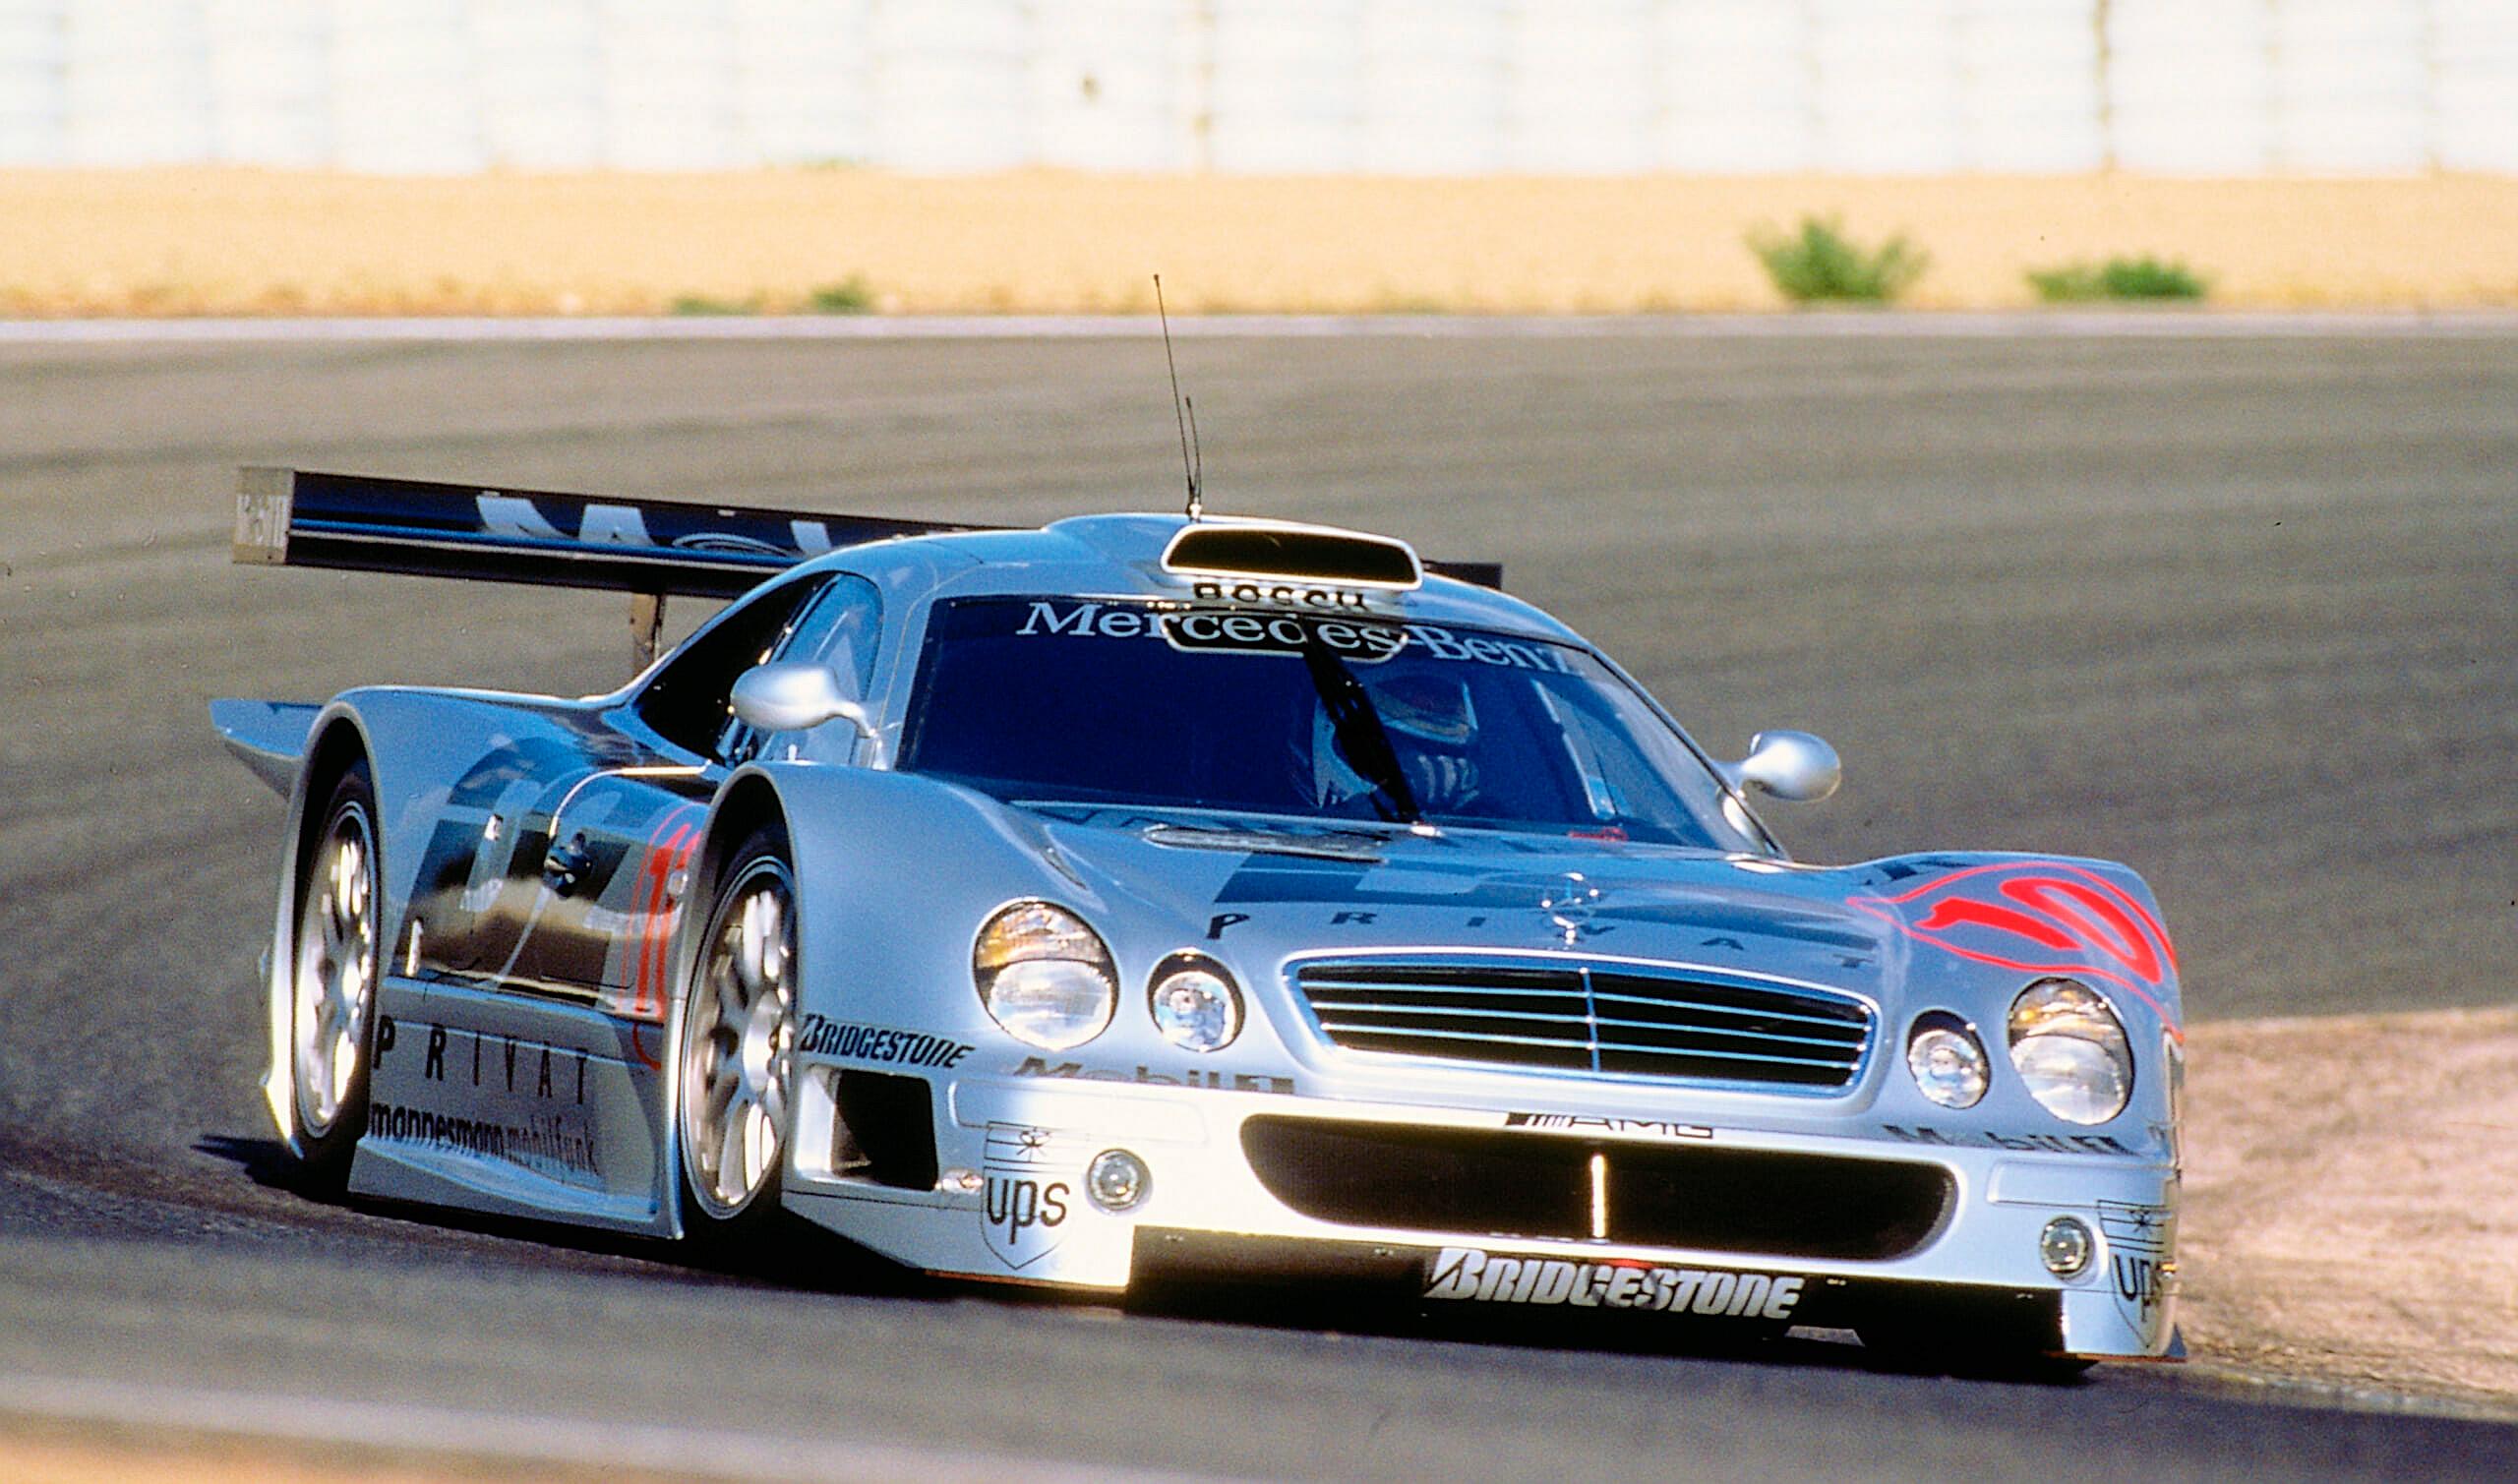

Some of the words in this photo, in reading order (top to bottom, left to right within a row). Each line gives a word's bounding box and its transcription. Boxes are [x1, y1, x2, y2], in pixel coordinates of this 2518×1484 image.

[373, 1014, 588, 1105] PRIVAT
[800, 1013, 976, 1069] BRIDGESTONE
[1567, 1115, 1714, 1140] AMG
[987, 1176, 1070, 1245] ups
[1423, 1246, 1804, 1319] BRIDGESTONE
